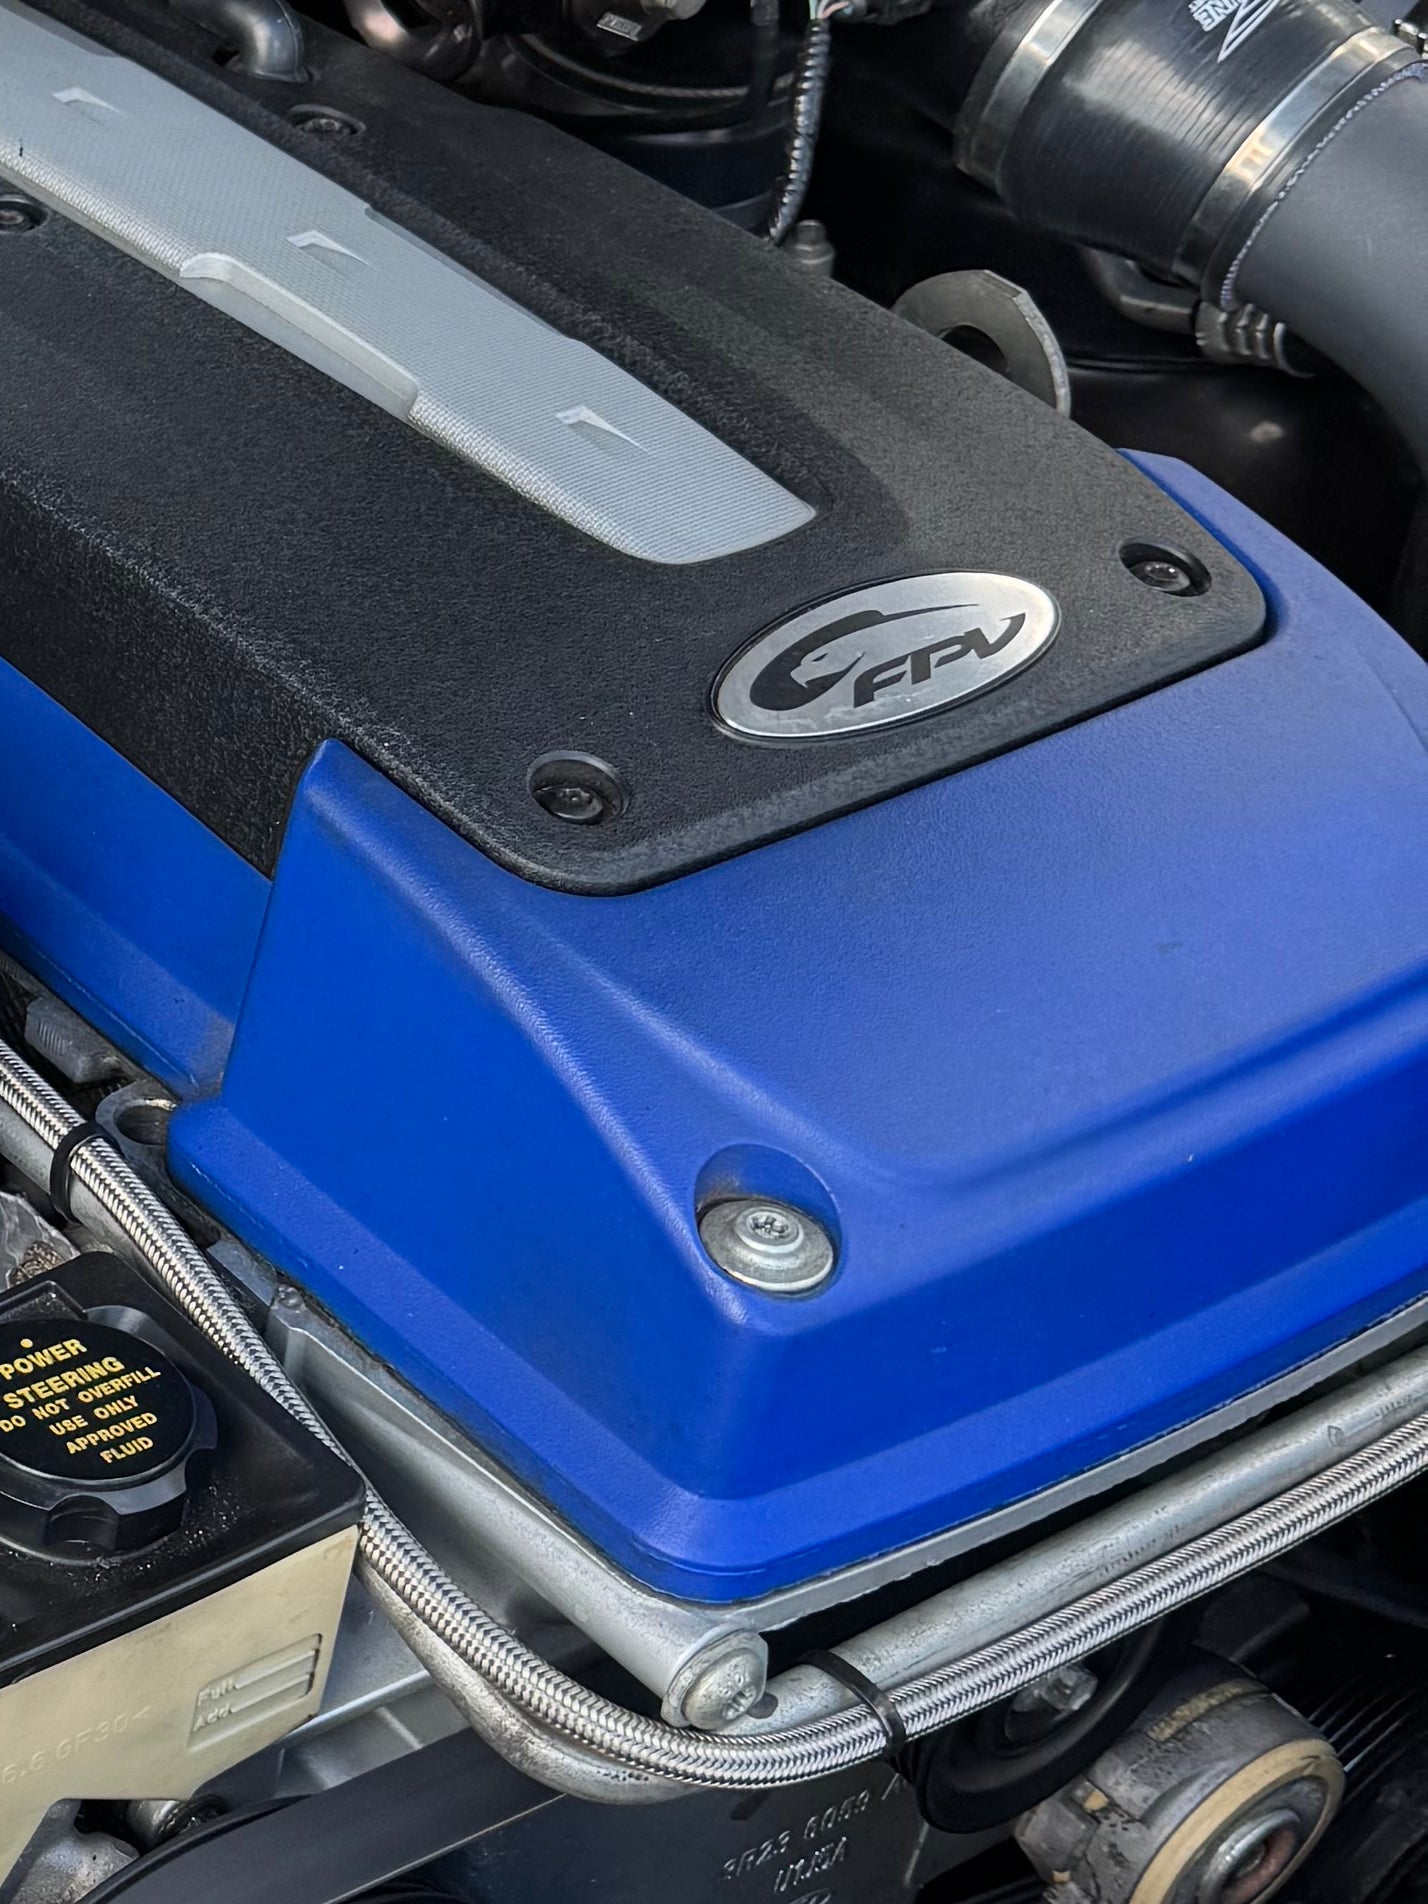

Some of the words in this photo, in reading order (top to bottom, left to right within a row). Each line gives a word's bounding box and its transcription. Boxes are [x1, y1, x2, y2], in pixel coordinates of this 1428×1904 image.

[853, 612, 1026, 709] FPV
[3, 1357, 125, 1409] STEERING
[31, 1398, 70, 1420] NOT
[77, 1366, 161, 1403] OVERFILL
[49, 1414, 89, 1436] USE
[94, 1395, 139, 1420] ONLY
[66, 1412, 158, 1455] APPROVED
[100, 1436, 154, 1464] FLUID
[197, 1677, 236, 1706] Full
[194, 1705, 233, 1731] Add
